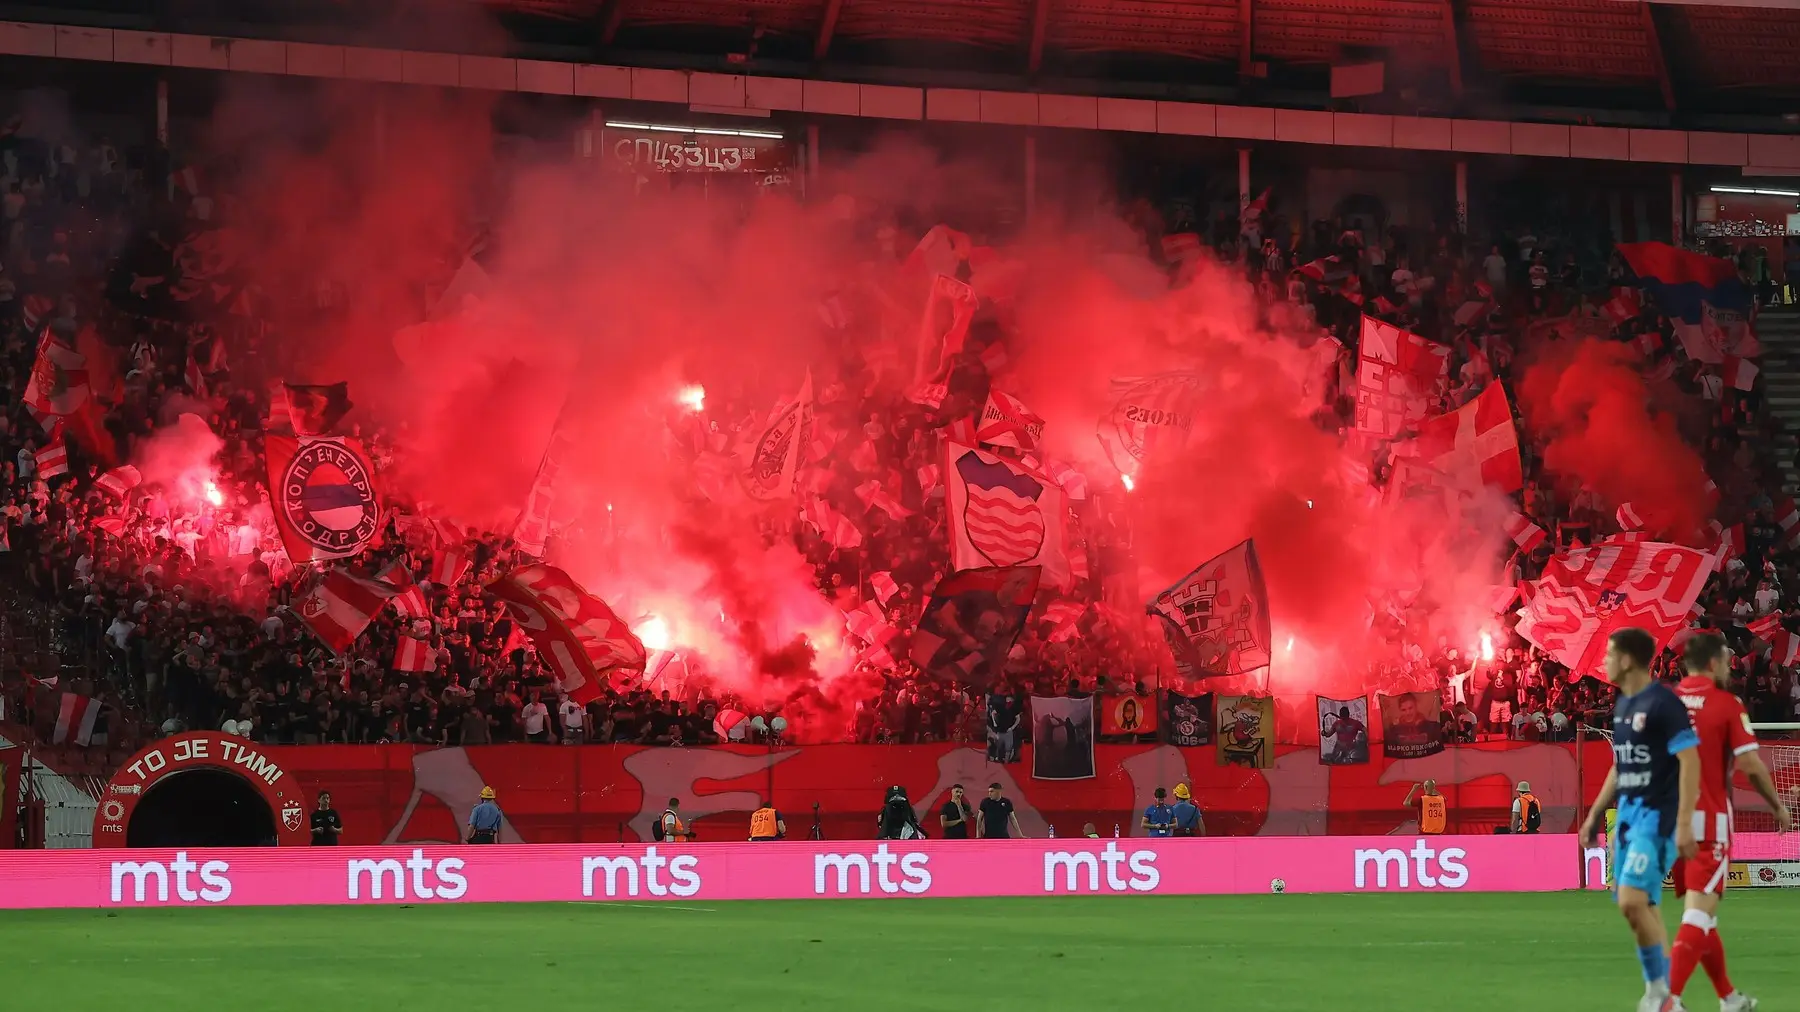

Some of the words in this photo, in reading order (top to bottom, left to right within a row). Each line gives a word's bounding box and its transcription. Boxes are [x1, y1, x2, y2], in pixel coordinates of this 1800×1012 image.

[127, 749, 166, 780] ТО
[174, 739, 209, 761] ЈЕ
[220, 740, 284, 785] ТИМ!
[102, 824, 122, 833] mts
[754, 814, 769, 822] 054
[1428, 809, 1443, 818] 034
[111, 850, 231, 903] mts
[347, 847, 468, 899] mts
[582, 846, 701, 897] mts
[814, 844, 932, 893] mts
[1043, 842, 1160, 892] mts
[1353, 839, 1469, 889] mts
